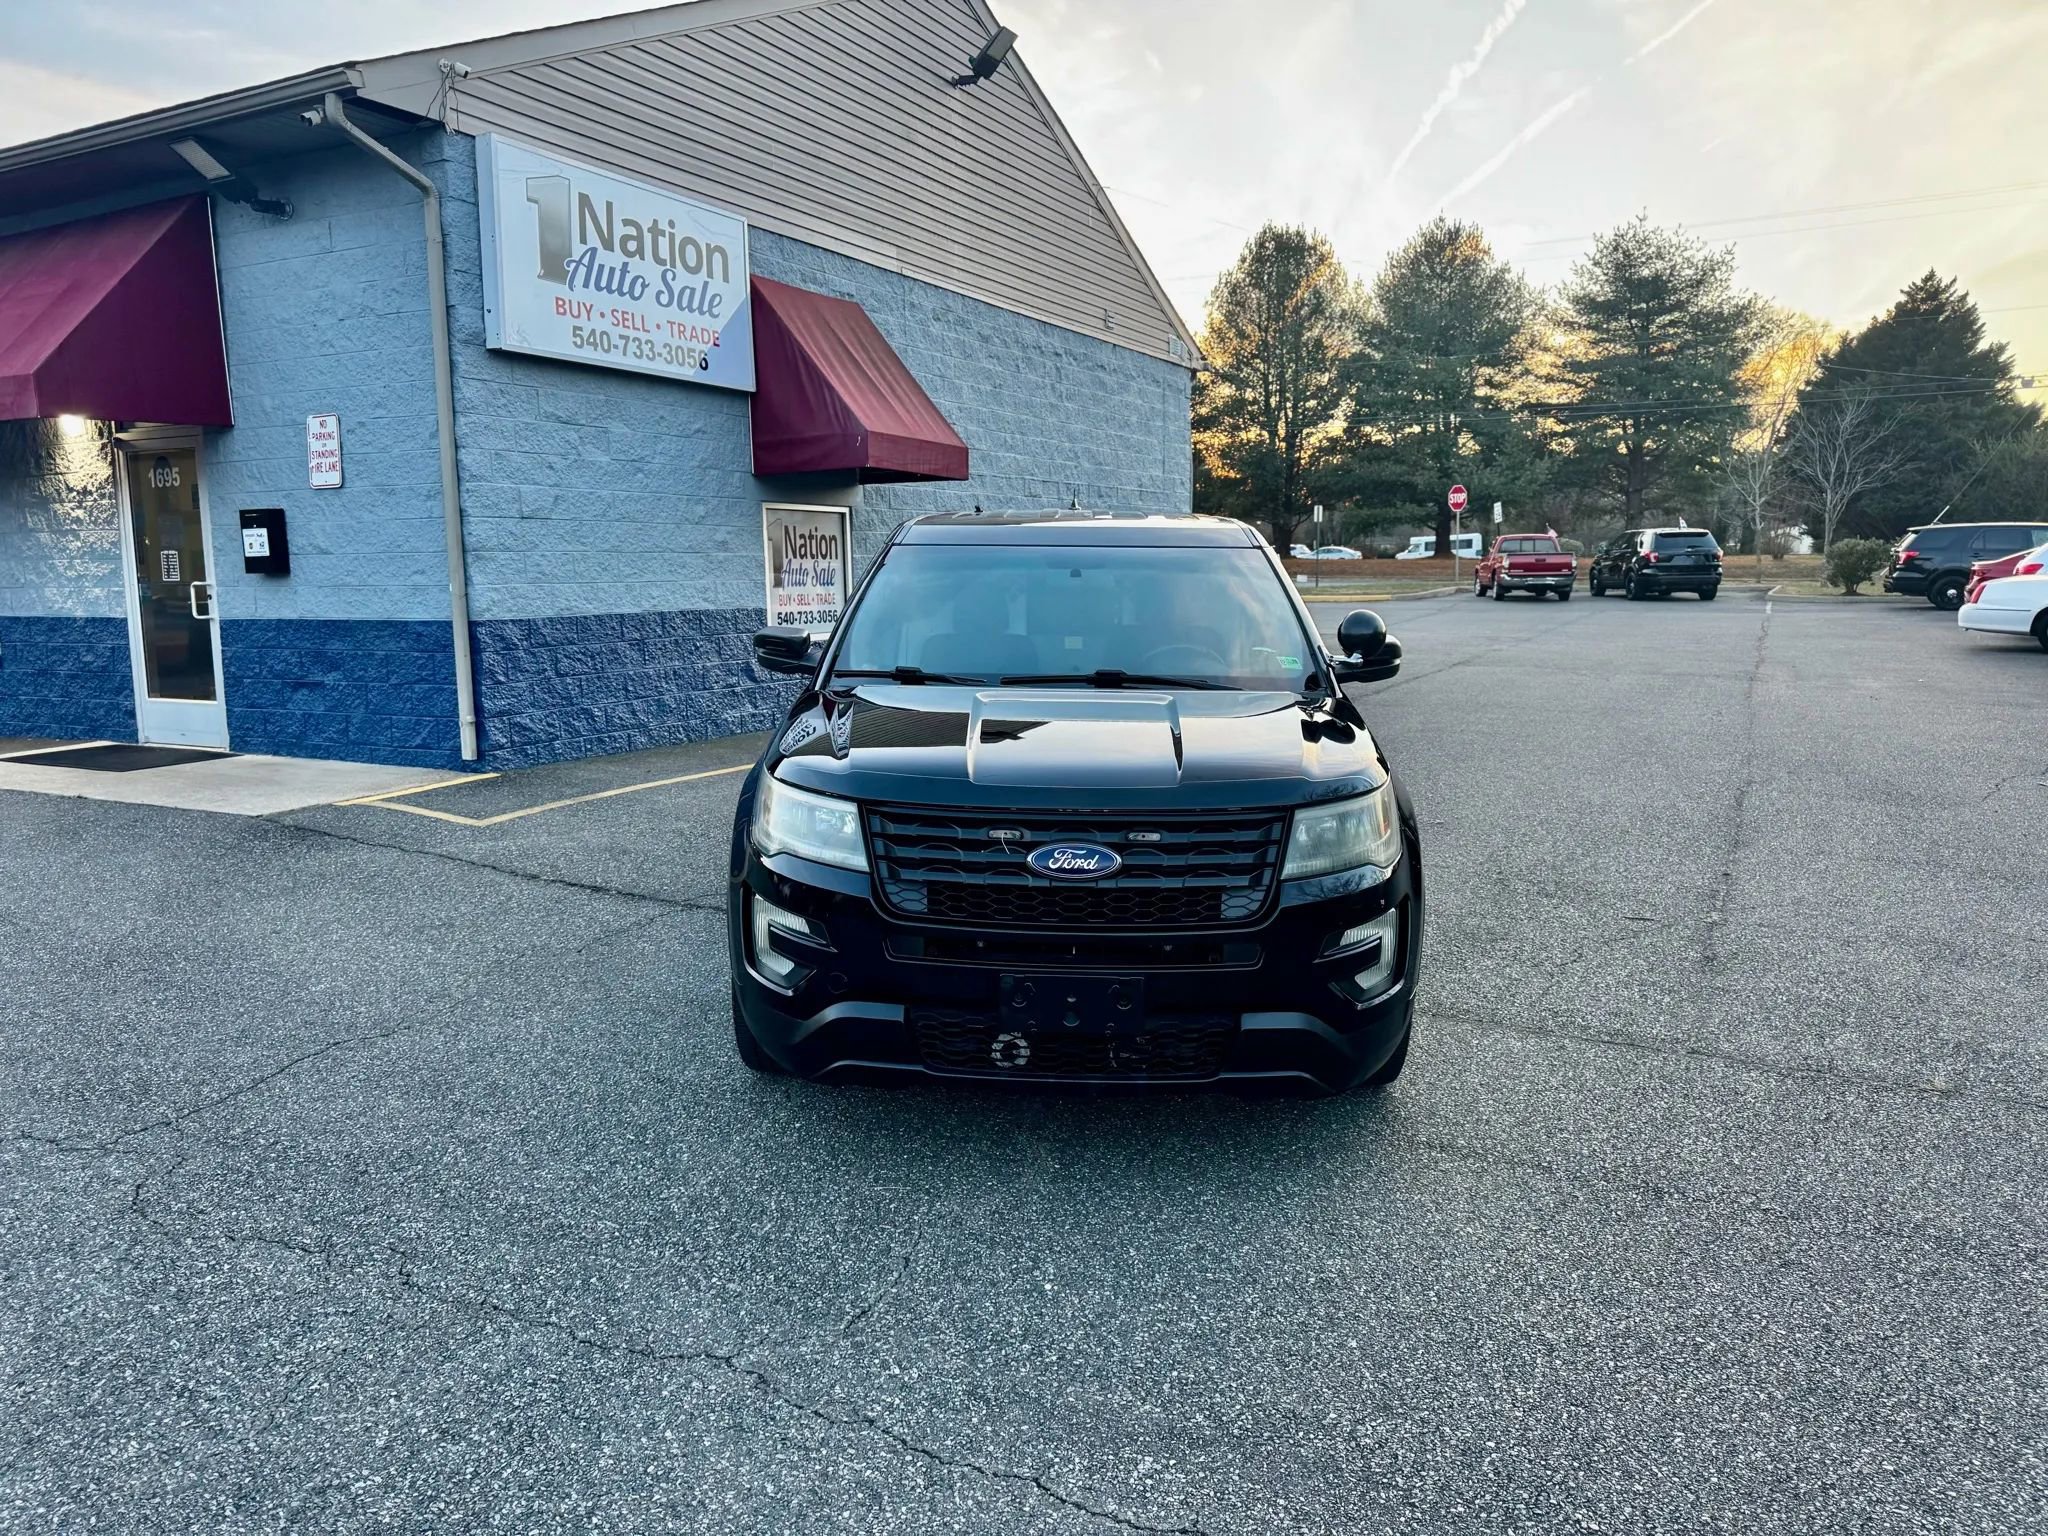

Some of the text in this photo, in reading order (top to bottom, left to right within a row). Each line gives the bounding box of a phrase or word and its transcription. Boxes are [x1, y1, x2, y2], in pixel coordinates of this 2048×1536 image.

[526, 175, 730, 286] 1 Nation
[565, 246, 723, 319] Auto Sale
[555, 296, 721, 348] BUY SELL TRADE
[572, 325, 709, 371] 540-733-3056
[319, 419, 328, 429] NO
[312, 431, 336, 441] PARKING
[311, 449, 338, 460] STANDING
[148, 466, 181, 488] 1695
[324, 461, 339, 473] LANE
[1449, 492, 1466, 504] STOP
[784, 525, 838, 560] Nation
[781, 558, 836, 590] Auto Sale
[778, 592, 836, 607] BUY SELL TRADE
[777, 609, 838, 625] 540-733-3056
[1048, 848, 1100, 870] Ford
